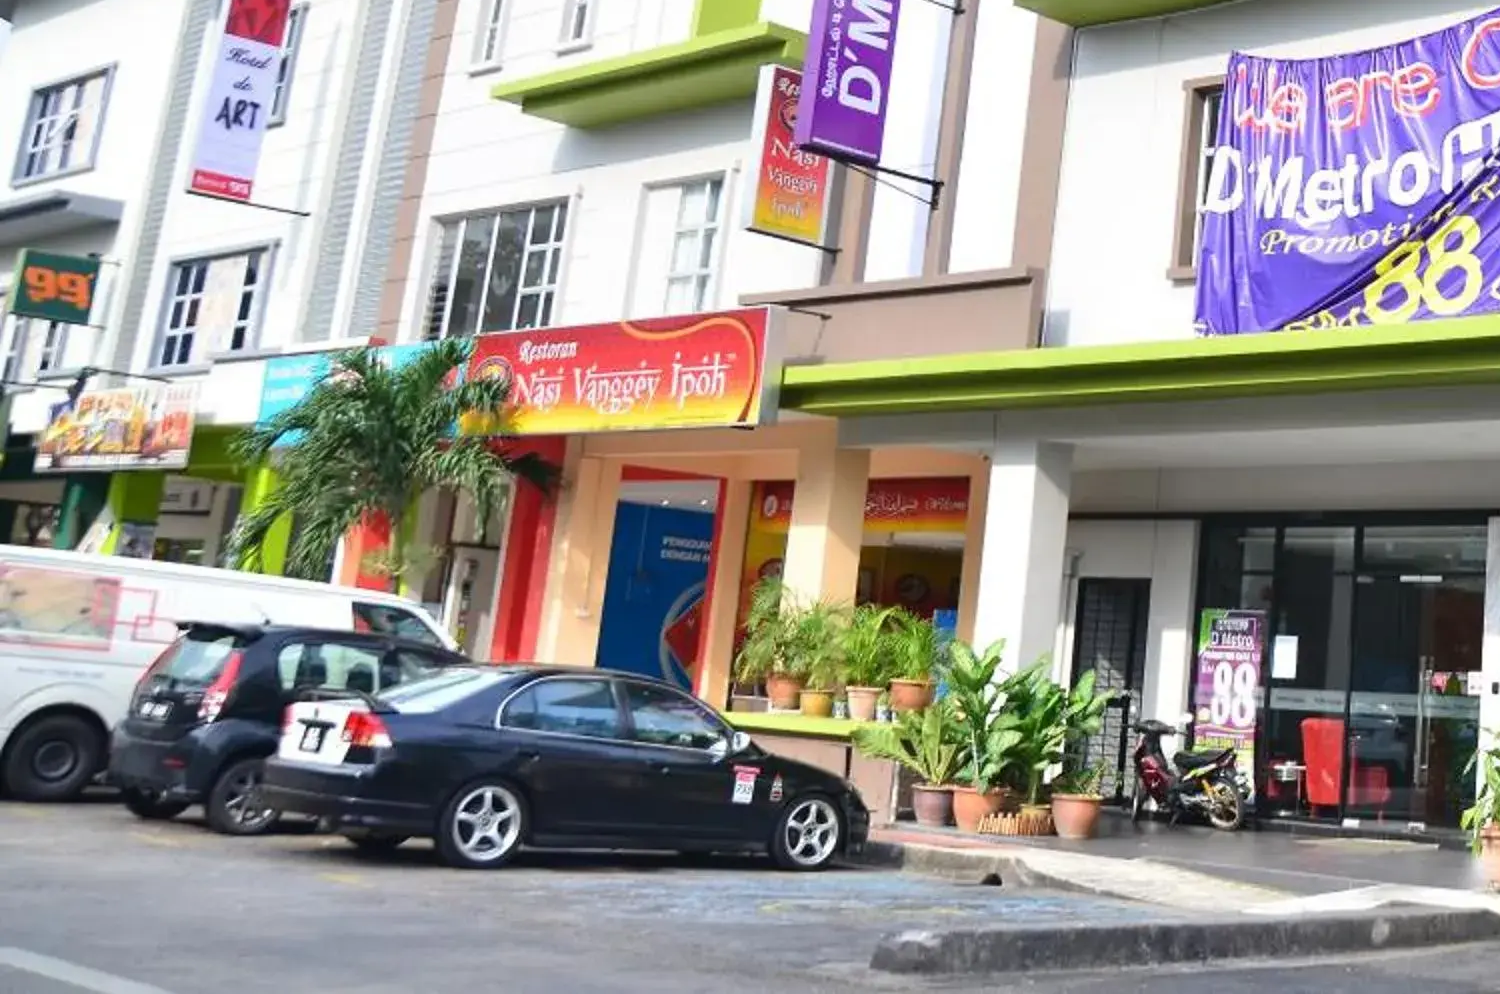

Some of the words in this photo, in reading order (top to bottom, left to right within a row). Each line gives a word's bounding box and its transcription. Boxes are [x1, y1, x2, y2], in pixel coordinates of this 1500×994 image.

[225, 47, 272, 70] Hotel
[233, 76, 254, 91] de
[1234, 62, 1307, 135] We
[1326, 62, 1441, 131] are
[215, 96, 262, 130] ART
[1260, 202, 1456, 255] Promotin
[24, 266, 94, 310] 99
[519, 339, 577, 365] Restoran
[513, 367, 566, 412] Nasi
[574, 360, 663, 414] Vanggey
[671, 352, 732, 412] Ipoh
[1211, 661, 1257, 728] 88
